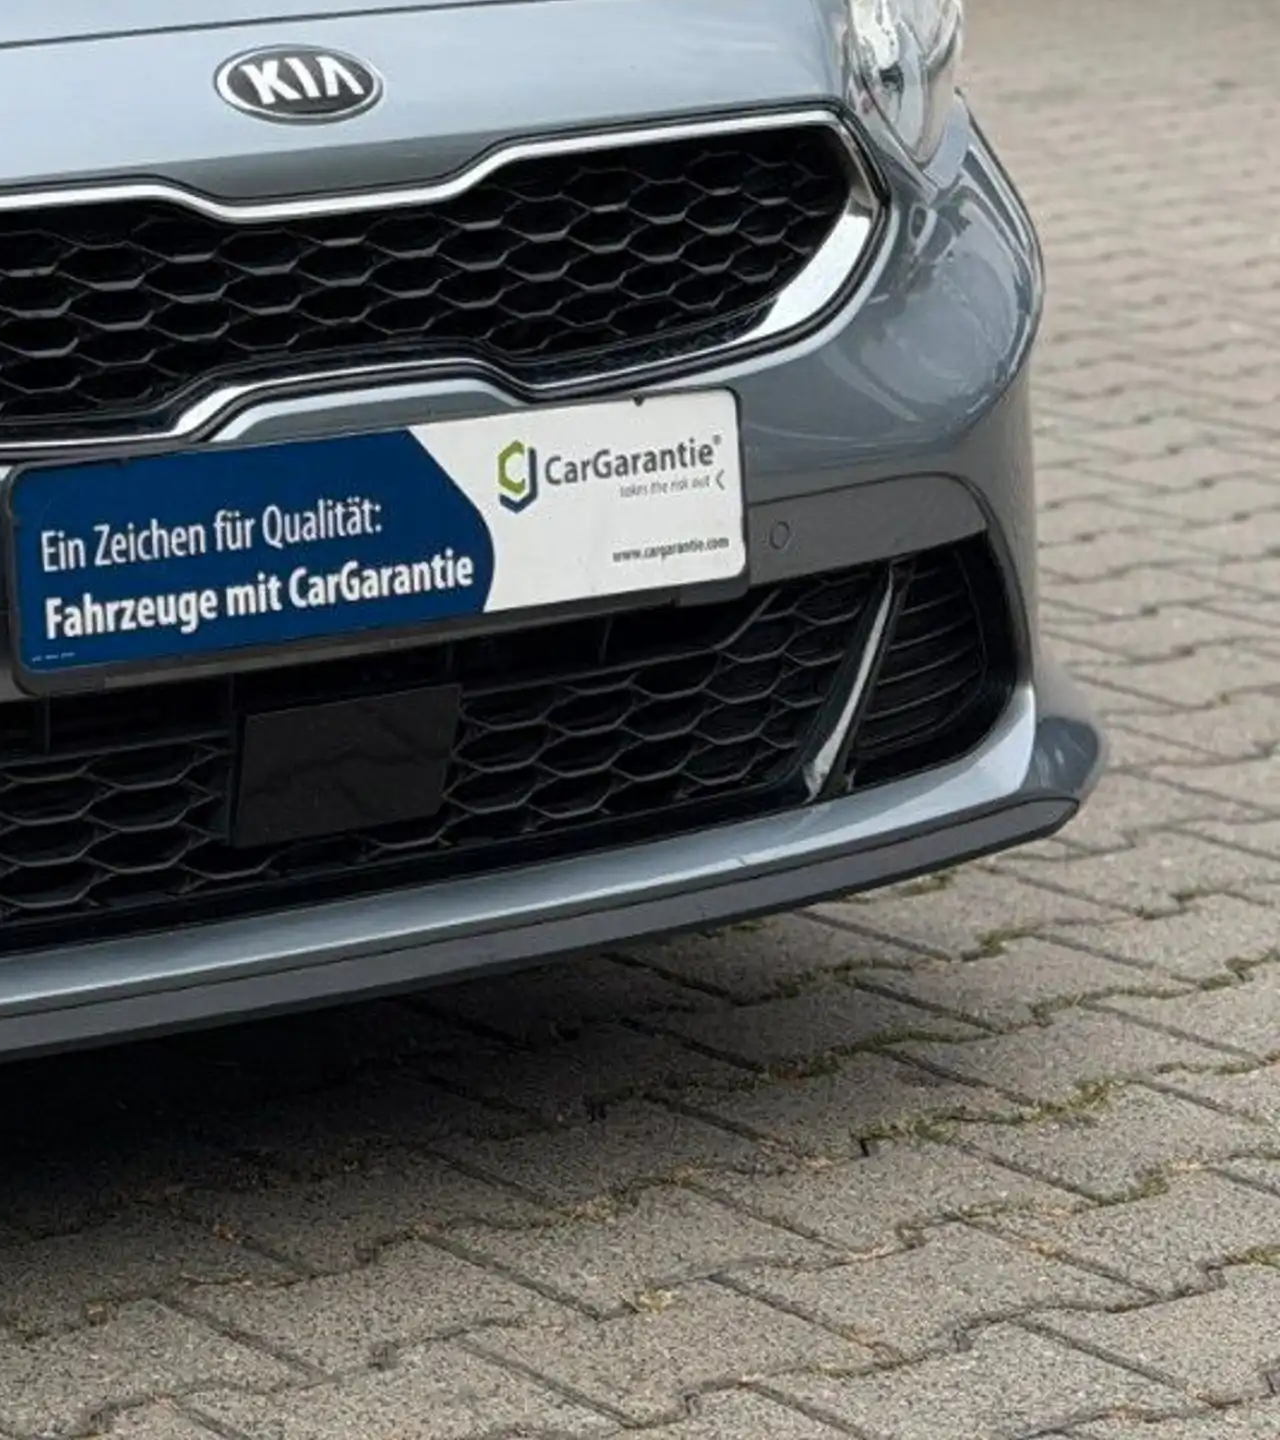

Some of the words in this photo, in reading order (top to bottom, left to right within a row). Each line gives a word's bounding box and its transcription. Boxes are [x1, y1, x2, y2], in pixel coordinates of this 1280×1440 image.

[241, 55, 365, 106] KIA
[40, 529, 86, 573] Ein
[92, 517, 207, 567] Zeichen
[212, 508, 256, 553] für
[261, 495, 383, 549] Qualität:
[612, 536, 730, 564] www.cargarantie.com
[45, 591, 219, 640] Fahrzeuge
[225, 570, 283, 617] mit
[288, 546, 475, 609] CarGarantie
